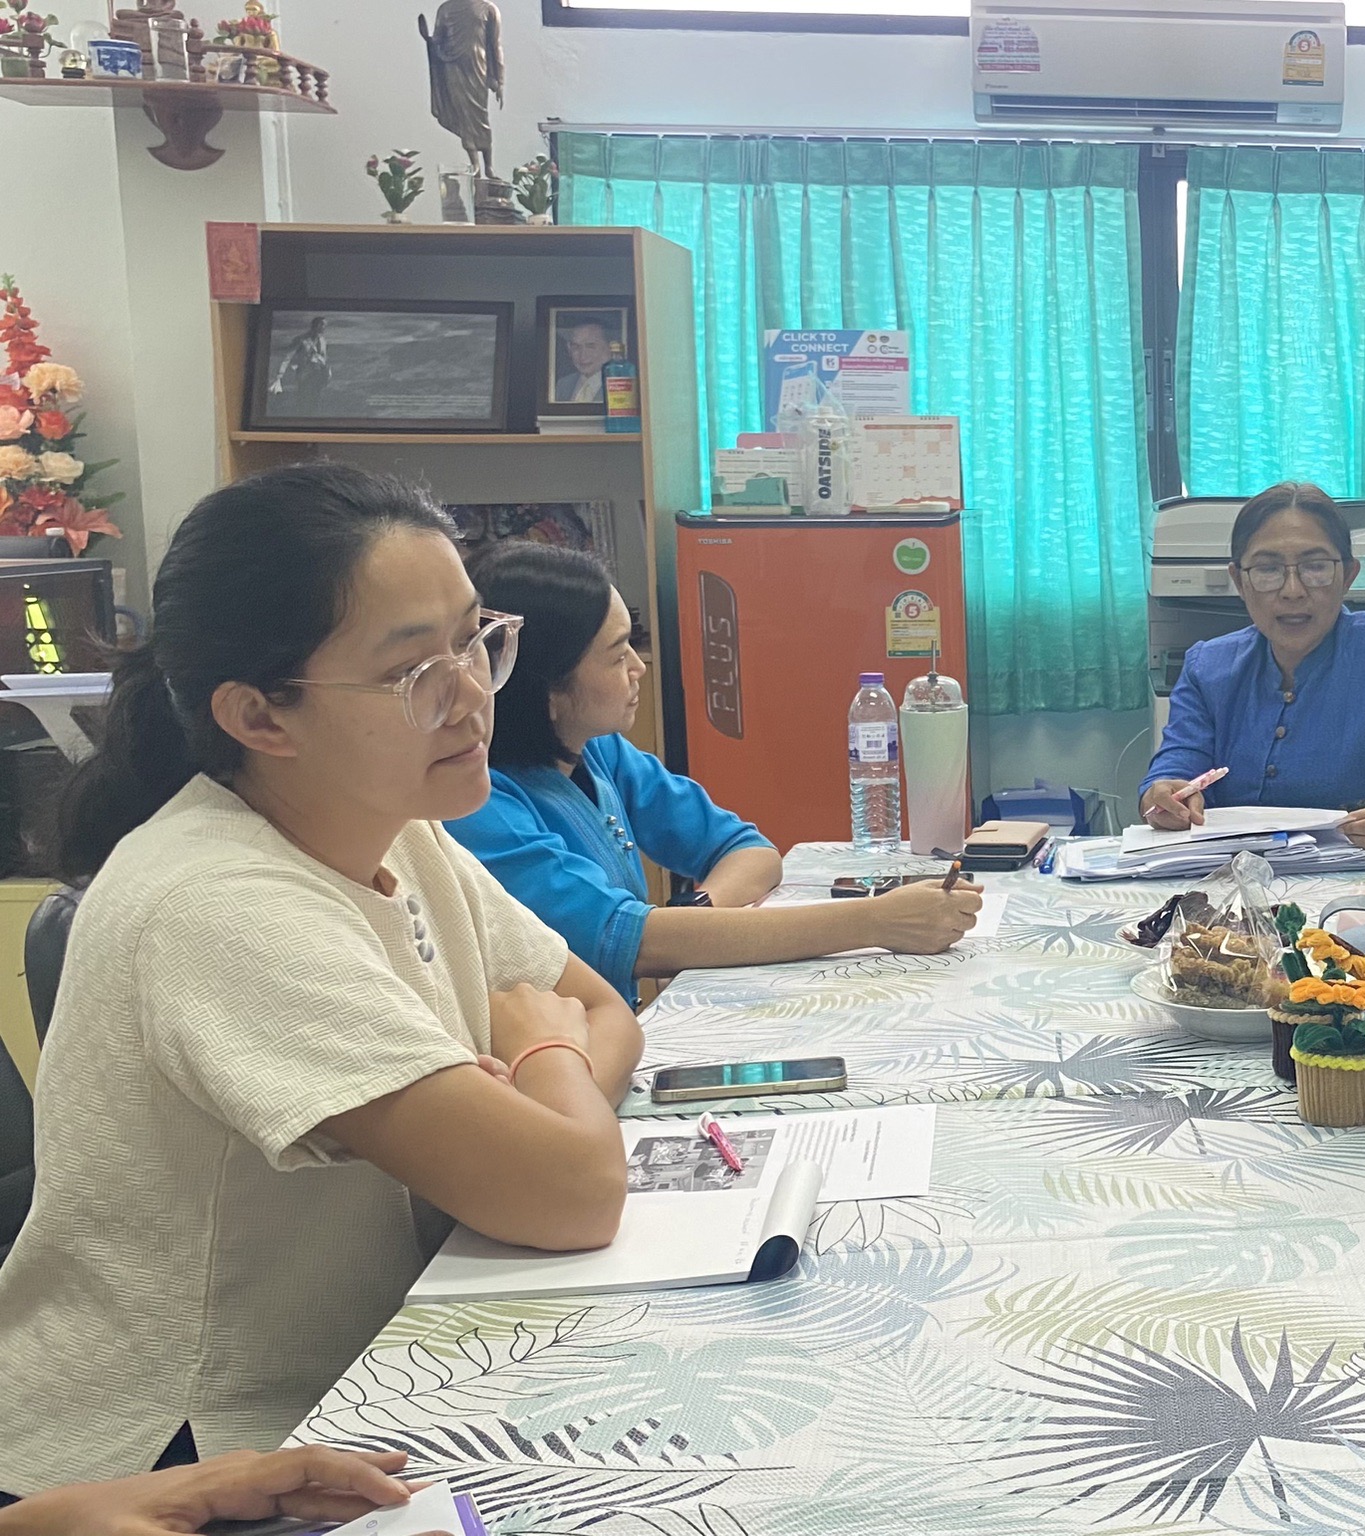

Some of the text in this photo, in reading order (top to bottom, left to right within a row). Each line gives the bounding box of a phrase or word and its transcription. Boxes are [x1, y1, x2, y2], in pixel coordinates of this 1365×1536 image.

[782, 332, 837, 342] CLICK TO
[790, 343, 849, 353] CONNECT
[818, 428, 833, 499] OATSIDE
[908, 606, 918, 617] 5
[708, 615, 736, 712] PLUS
